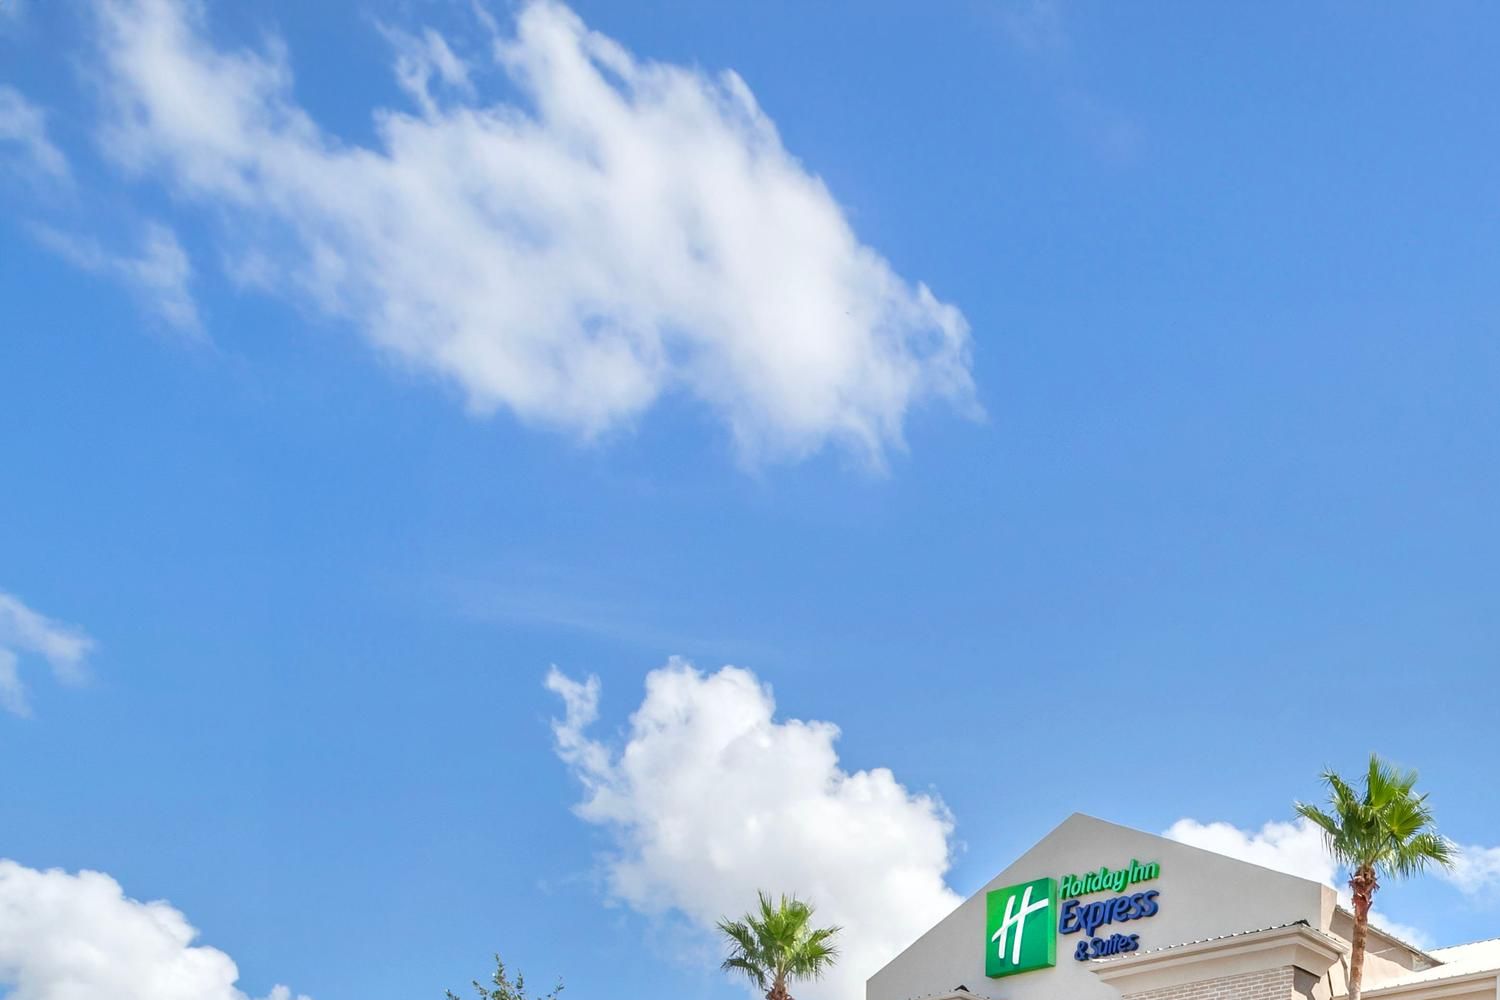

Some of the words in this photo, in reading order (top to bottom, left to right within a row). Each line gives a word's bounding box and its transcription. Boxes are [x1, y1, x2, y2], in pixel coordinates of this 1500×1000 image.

[1060, 866, 1129, 900] Holiday
[1128, 858, 1160, 884] Inn
[1058, 890, 1160, 937] Express
[1074, 940, 1089, 961] &
[1088, 933, 1139, 959] Suites
